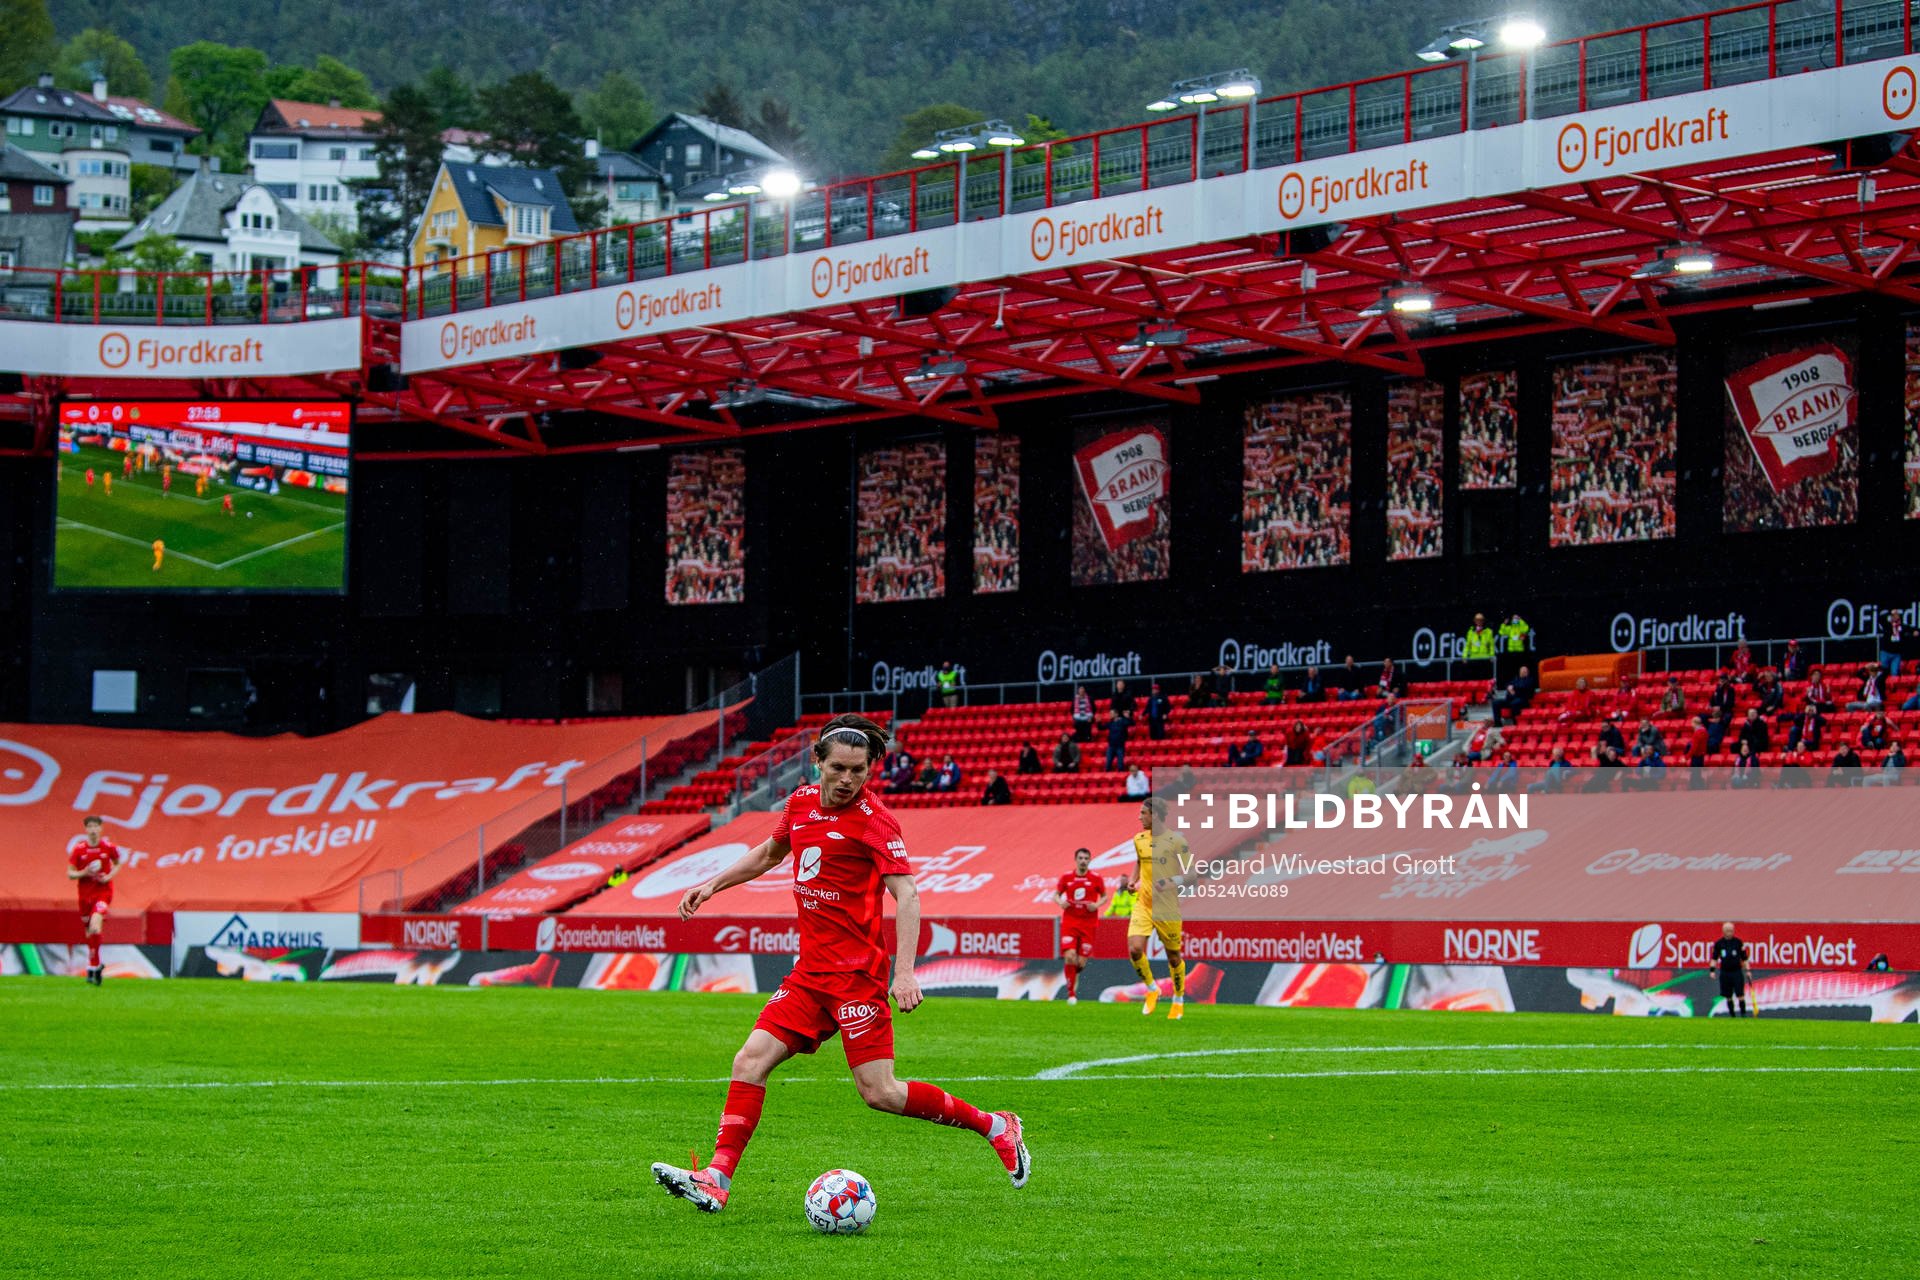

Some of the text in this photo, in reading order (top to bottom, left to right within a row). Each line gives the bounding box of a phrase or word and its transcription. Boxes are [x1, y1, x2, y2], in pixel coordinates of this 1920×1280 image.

[1595, 108, 1728, 166] Fjordkraft
[1311, 159, 1428, 213] Fjordkraft
[1059, 206, 1162, 255] Fjordkraft
[836, 247, 929, 294] Fjordkraft
[638, 285, 722, 326] Fjordkraft
[460, 315, 537, 350] Fjordkraft
[137, 339, 263, 369] Fjordkraft
[1781, 366, 1820, 390] 1908
[1773, 388, 1841, 432] BRANN
[1114, 444, 1144, 464] 1908
[1639, 612, 1745, 648] Fjordkraft
[1060, 651, 1141, 684] Fjordkraft
[1244, 640, 1331, 672] Fjordkraft
[72, 759, 586, 828] Fjordkraft
[156, 846, 204, 868] en
[216, 819, 376, 863] forskjell
[228, 930, 322, 949] MARKHUS
[556, 924, 666, 949] SparebankenVest
[960, 932, 1021, 955] BRAGE
[1443, 928, 1541, 962] NORNE
[1664, 933, 1857, 967] SparankenVest
